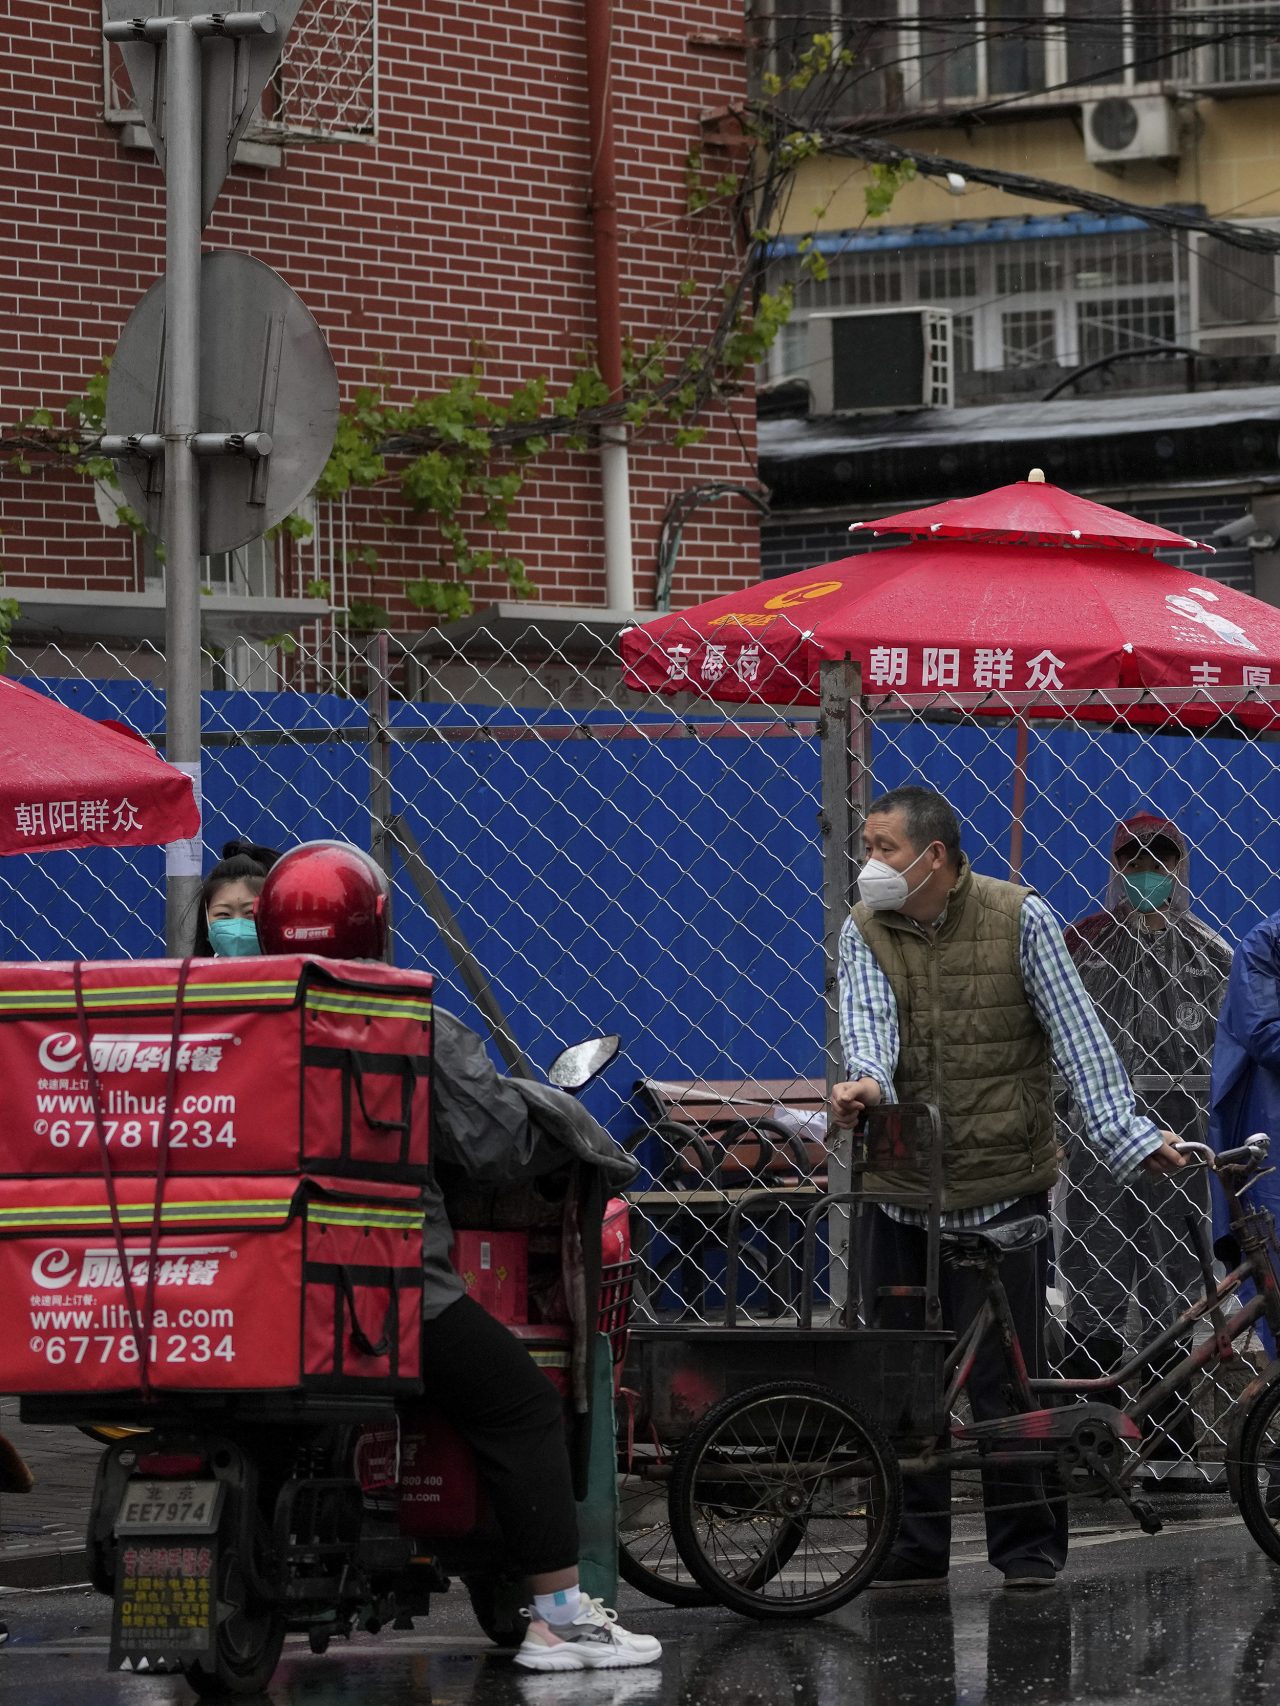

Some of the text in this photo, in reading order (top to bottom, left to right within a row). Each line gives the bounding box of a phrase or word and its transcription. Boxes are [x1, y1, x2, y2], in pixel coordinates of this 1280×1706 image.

[666, 643, 761, 683] 志愿岗
[869, 645, 1066, 691] 朝阳群众
[13, 796, 144, 837] 朝阳群众
[50, 1119, 237, 1148] 67781234
[46, 1334, 236, 1364] 67781234
[146, 1484, 196, 1500] 北京
[125, 1502, 206, 1522] EE7974
